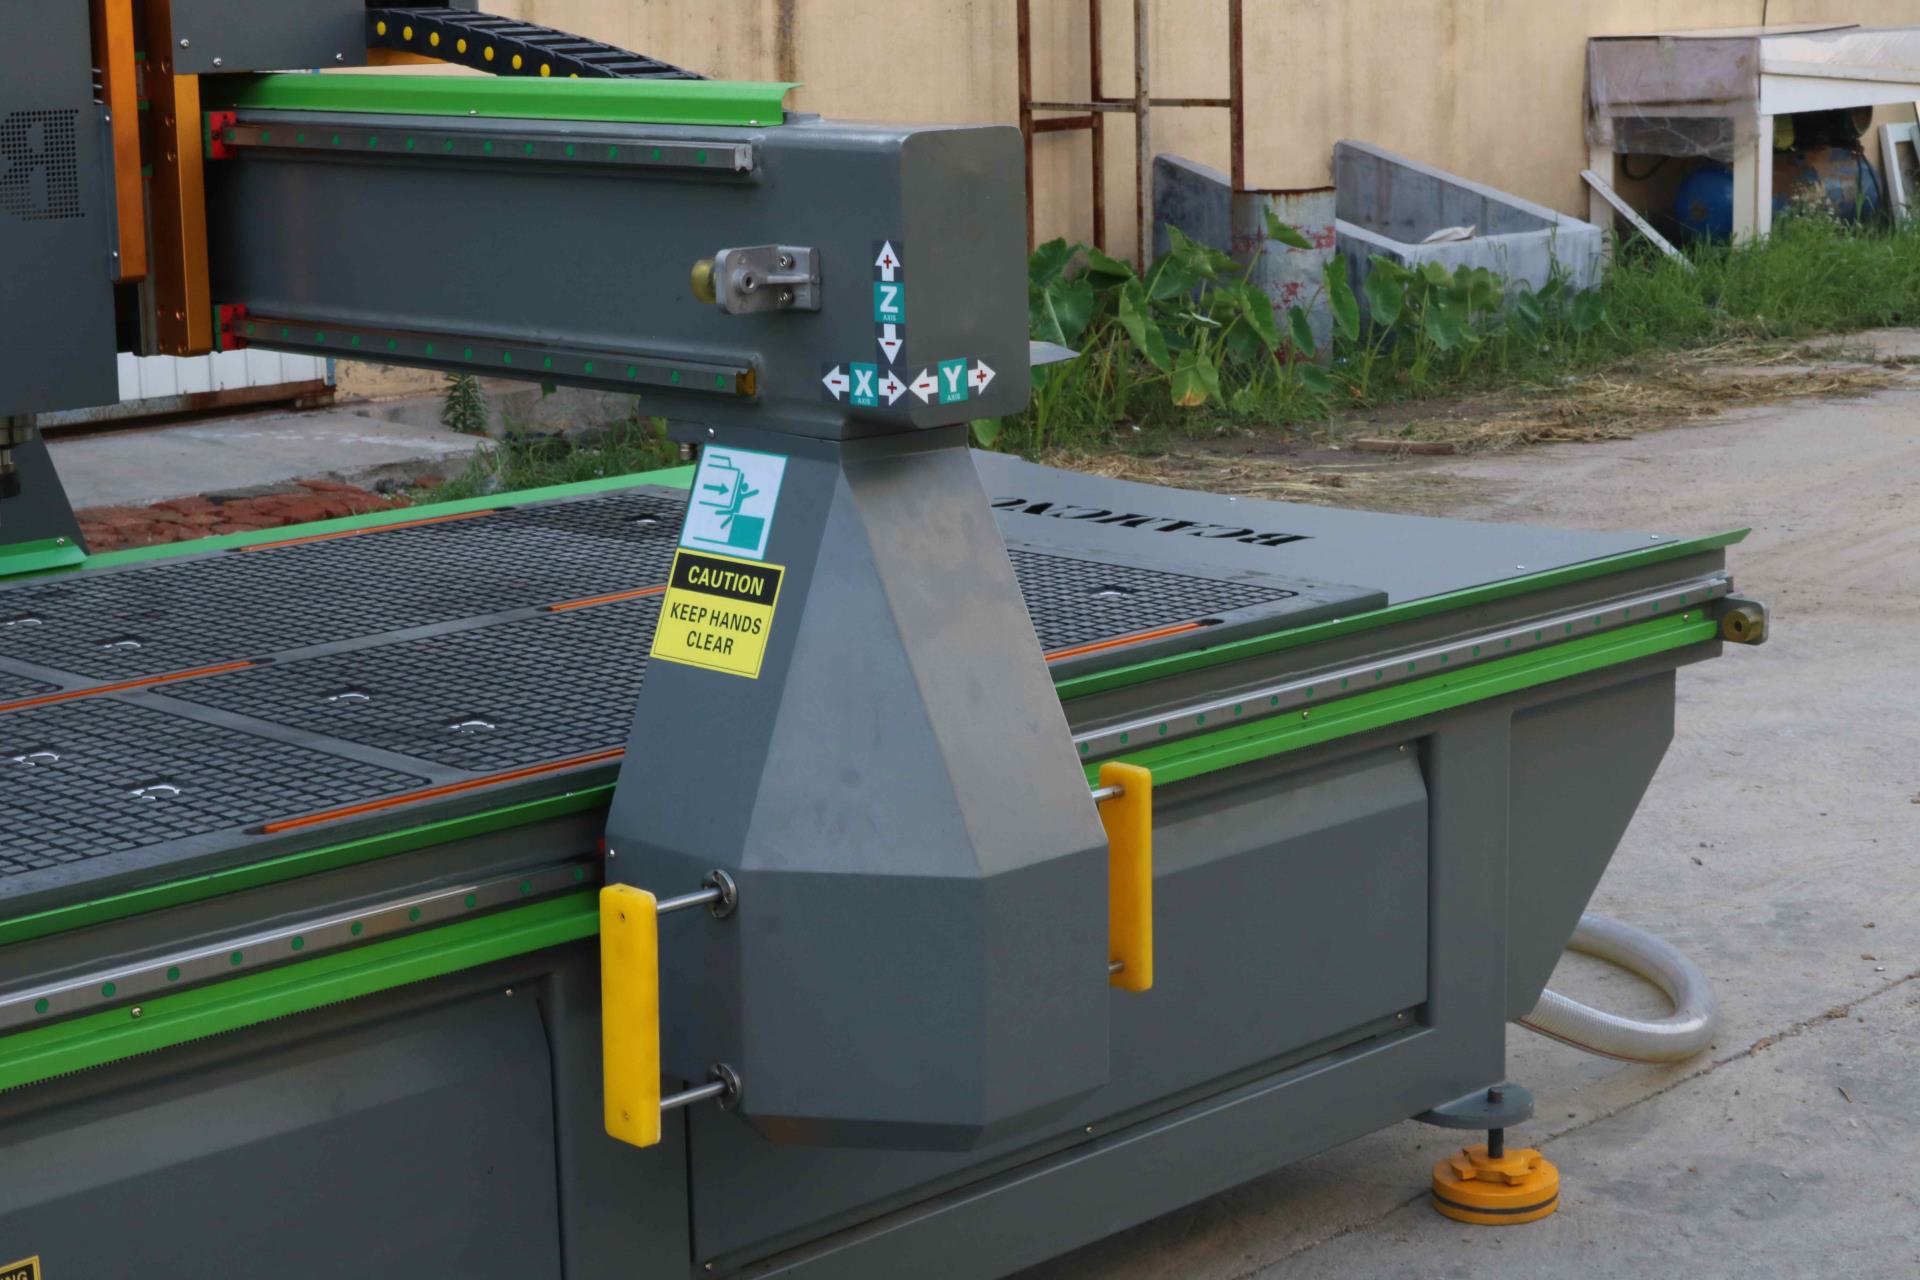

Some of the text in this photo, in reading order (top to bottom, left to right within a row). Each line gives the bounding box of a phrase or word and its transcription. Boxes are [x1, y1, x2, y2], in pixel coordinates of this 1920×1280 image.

[880, 286, 899, 313] Z
[854, 369, 873, 397] X
[943, 365, 962, 393] Y
[947, 393, 960, 401] AXIS
[688, 565, 764, 596] CAUTION
[670, 602, 762, 635] KEEP HANDS
[686, 631, 734, 655] CLEAR
